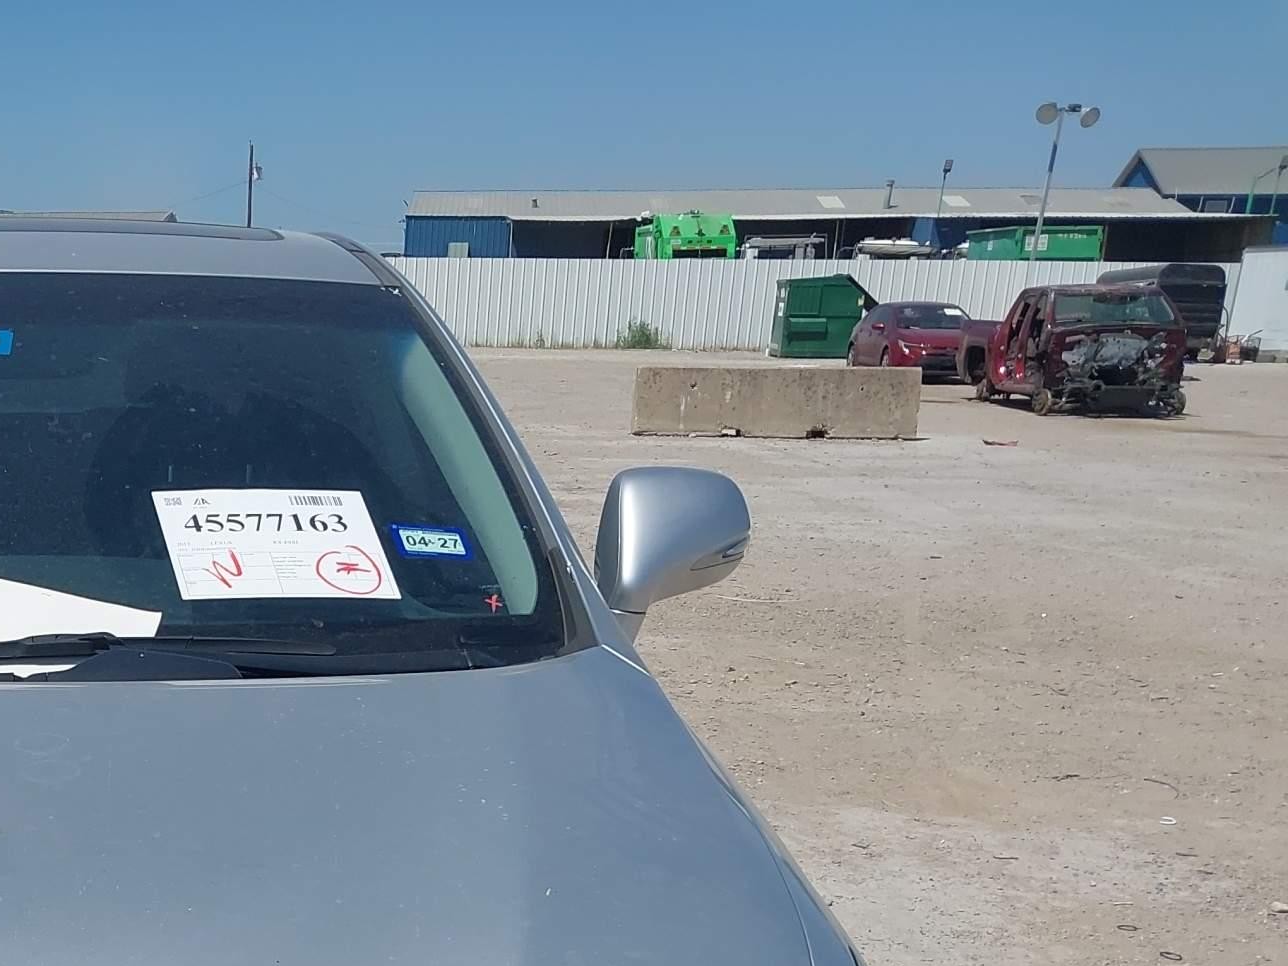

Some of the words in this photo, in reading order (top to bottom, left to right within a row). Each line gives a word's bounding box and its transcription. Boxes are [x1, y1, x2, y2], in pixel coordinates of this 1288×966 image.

[184, 513, 348, 532] 45577163
[405, 535, 429, 547] 04
[437, 537, 460, 549] 27
